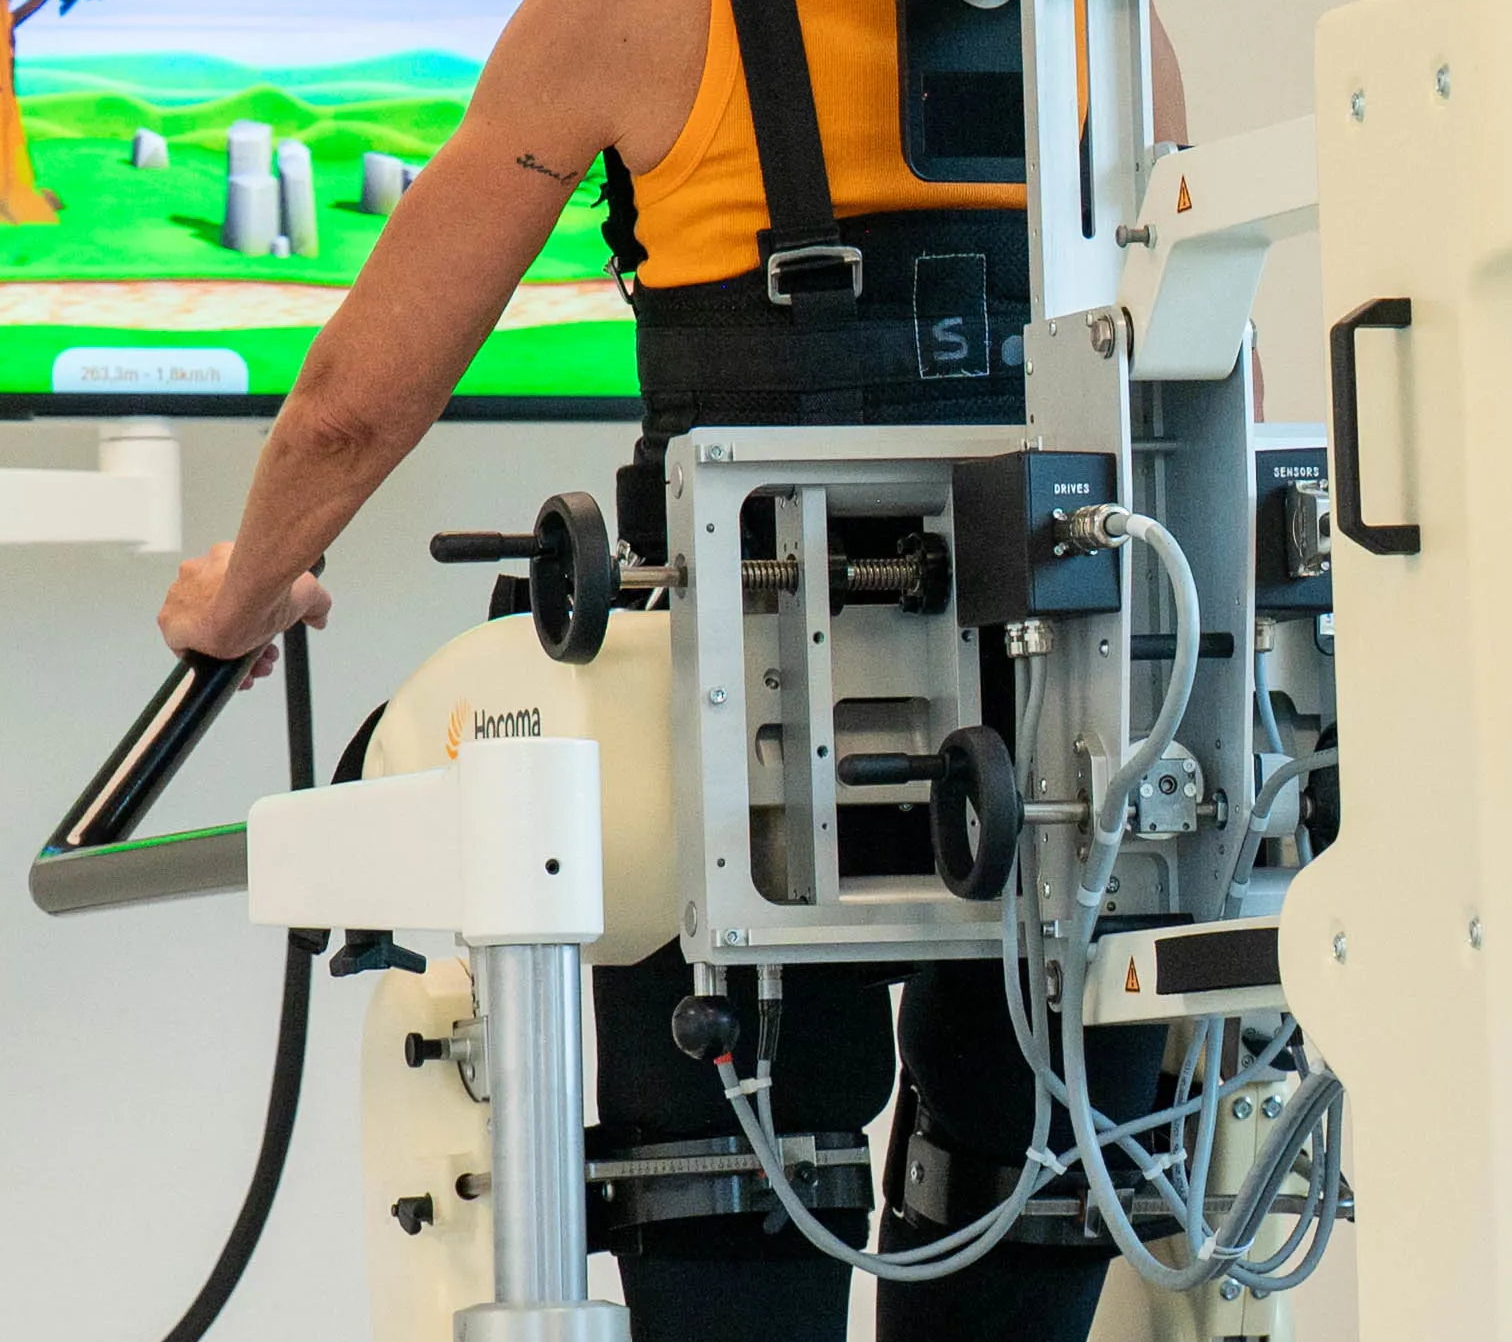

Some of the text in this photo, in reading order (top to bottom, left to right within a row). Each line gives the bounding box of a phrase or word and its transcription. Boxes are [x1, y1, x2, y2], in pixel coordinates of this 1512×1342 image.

[932, 316, 968, 360] S
[1273, 466, 1320, 478] SENSORS
[1054, 482, 1090, 495] DRIVES
[474, 706, 541, 739] Hocoma
